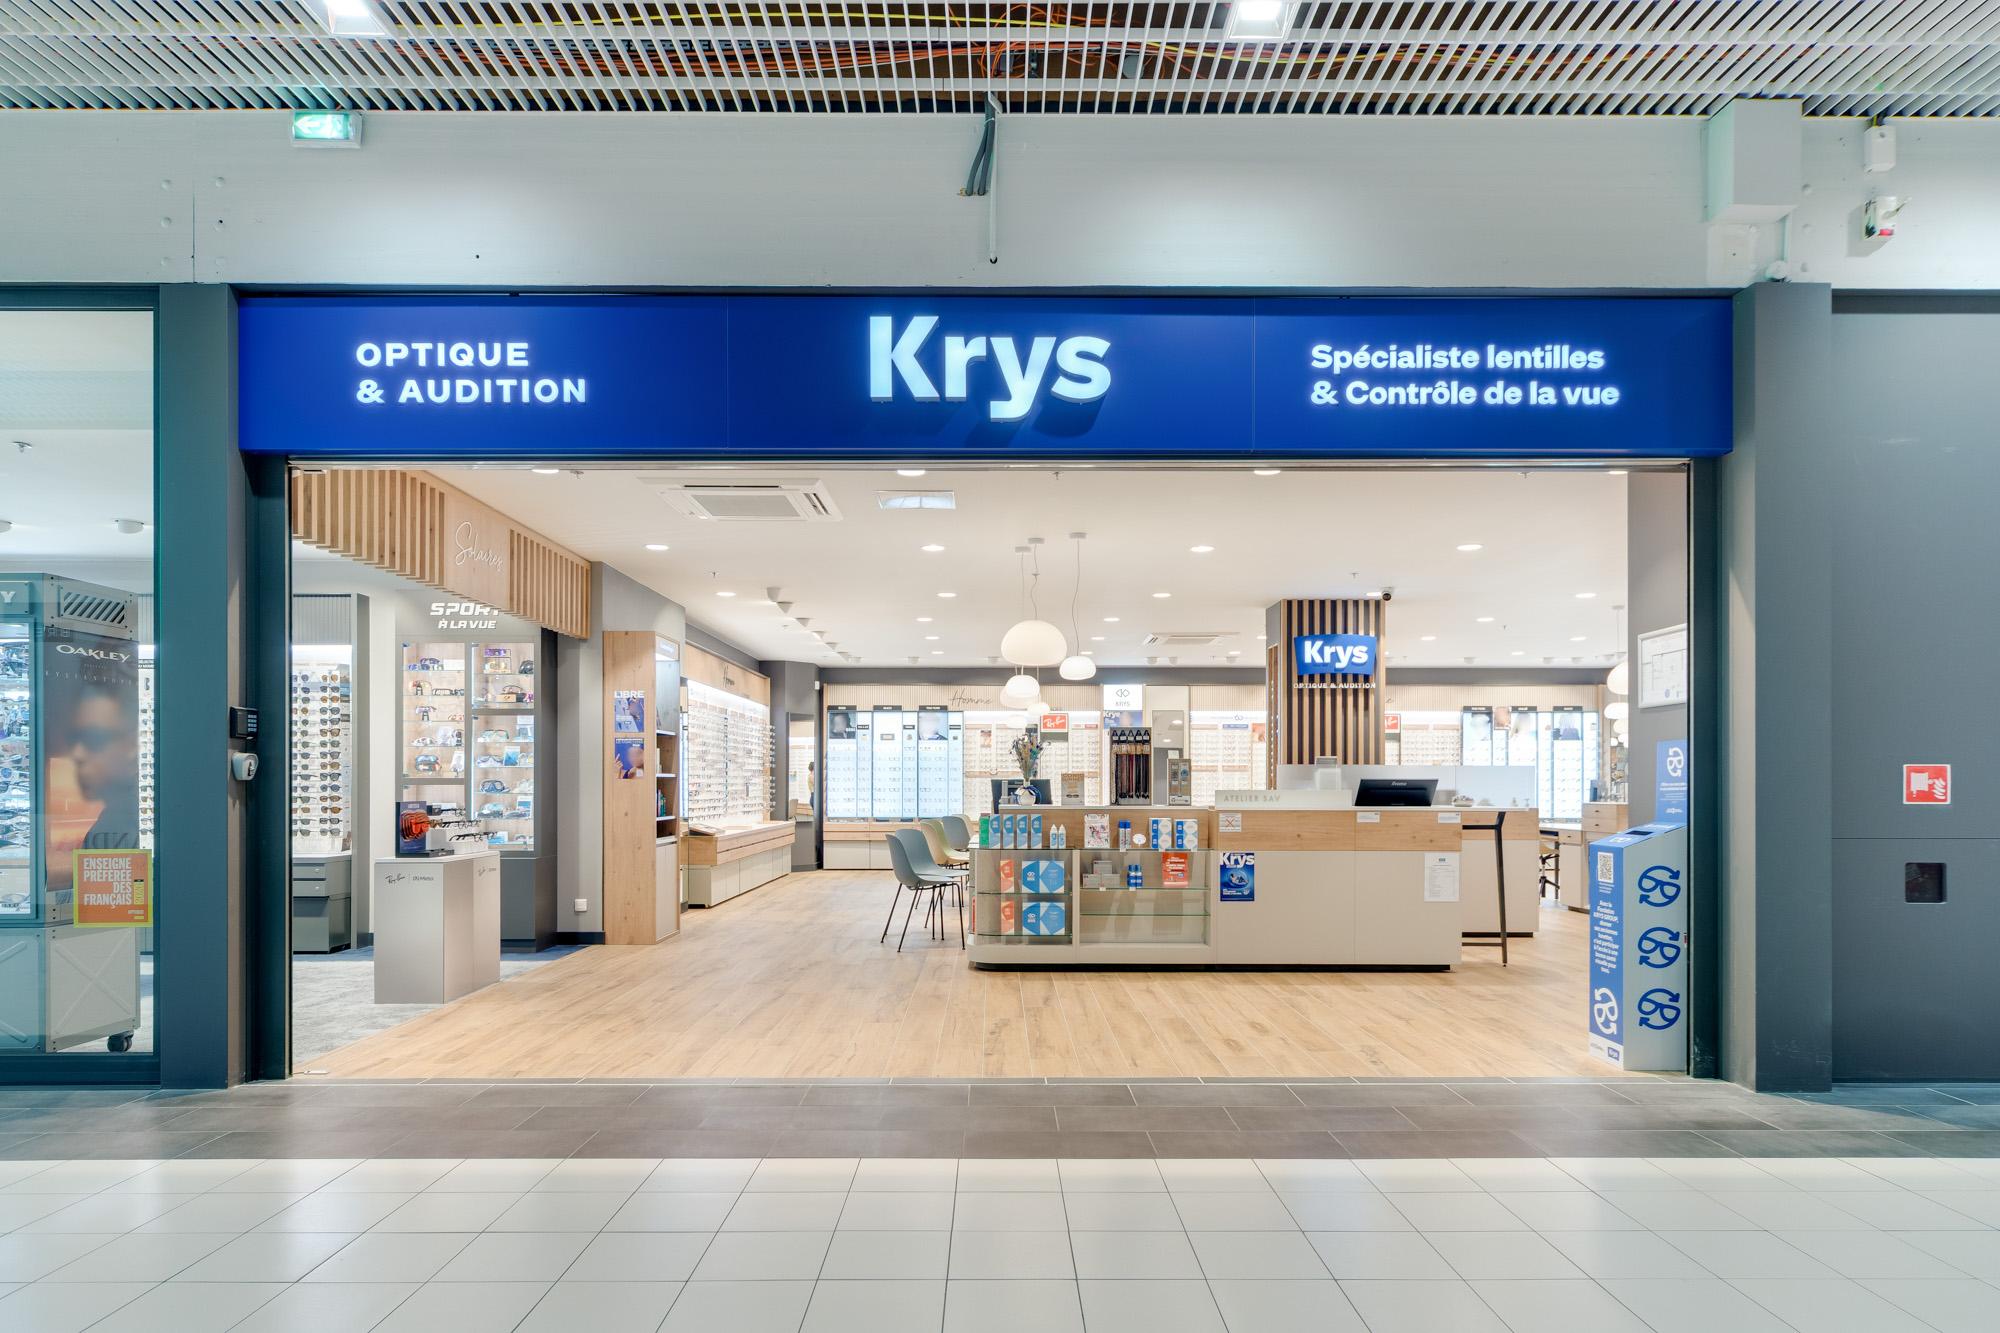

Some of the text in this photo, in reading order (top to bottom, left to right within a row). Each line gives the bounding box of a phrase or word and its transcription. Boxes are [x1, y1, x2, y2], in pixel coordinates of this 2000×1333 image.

[355, 341, 530, 368] OPTIQUE
[1311, 344, 1605, 374] Spécialiste lentilles
[869, 315, 1112, 422] Krys
[355, 378, 587, 404] & AUDITION
[1311, 380, 1621, 405] & Contrôle de la vue
[468, 620, 497, 629] VUE
[55, 644, 131, 663] OAKLEY
[1304, 640, 1368, 669] Krys
[614, 690, 645, 699] LIBRE
[83, 858, 132, 869] ENSEIGNE
[1220, 852, 1255, 868] Krys
[112, 882, 132, 893] DES
[83, 893, 132, 909] FRANÇAIS
